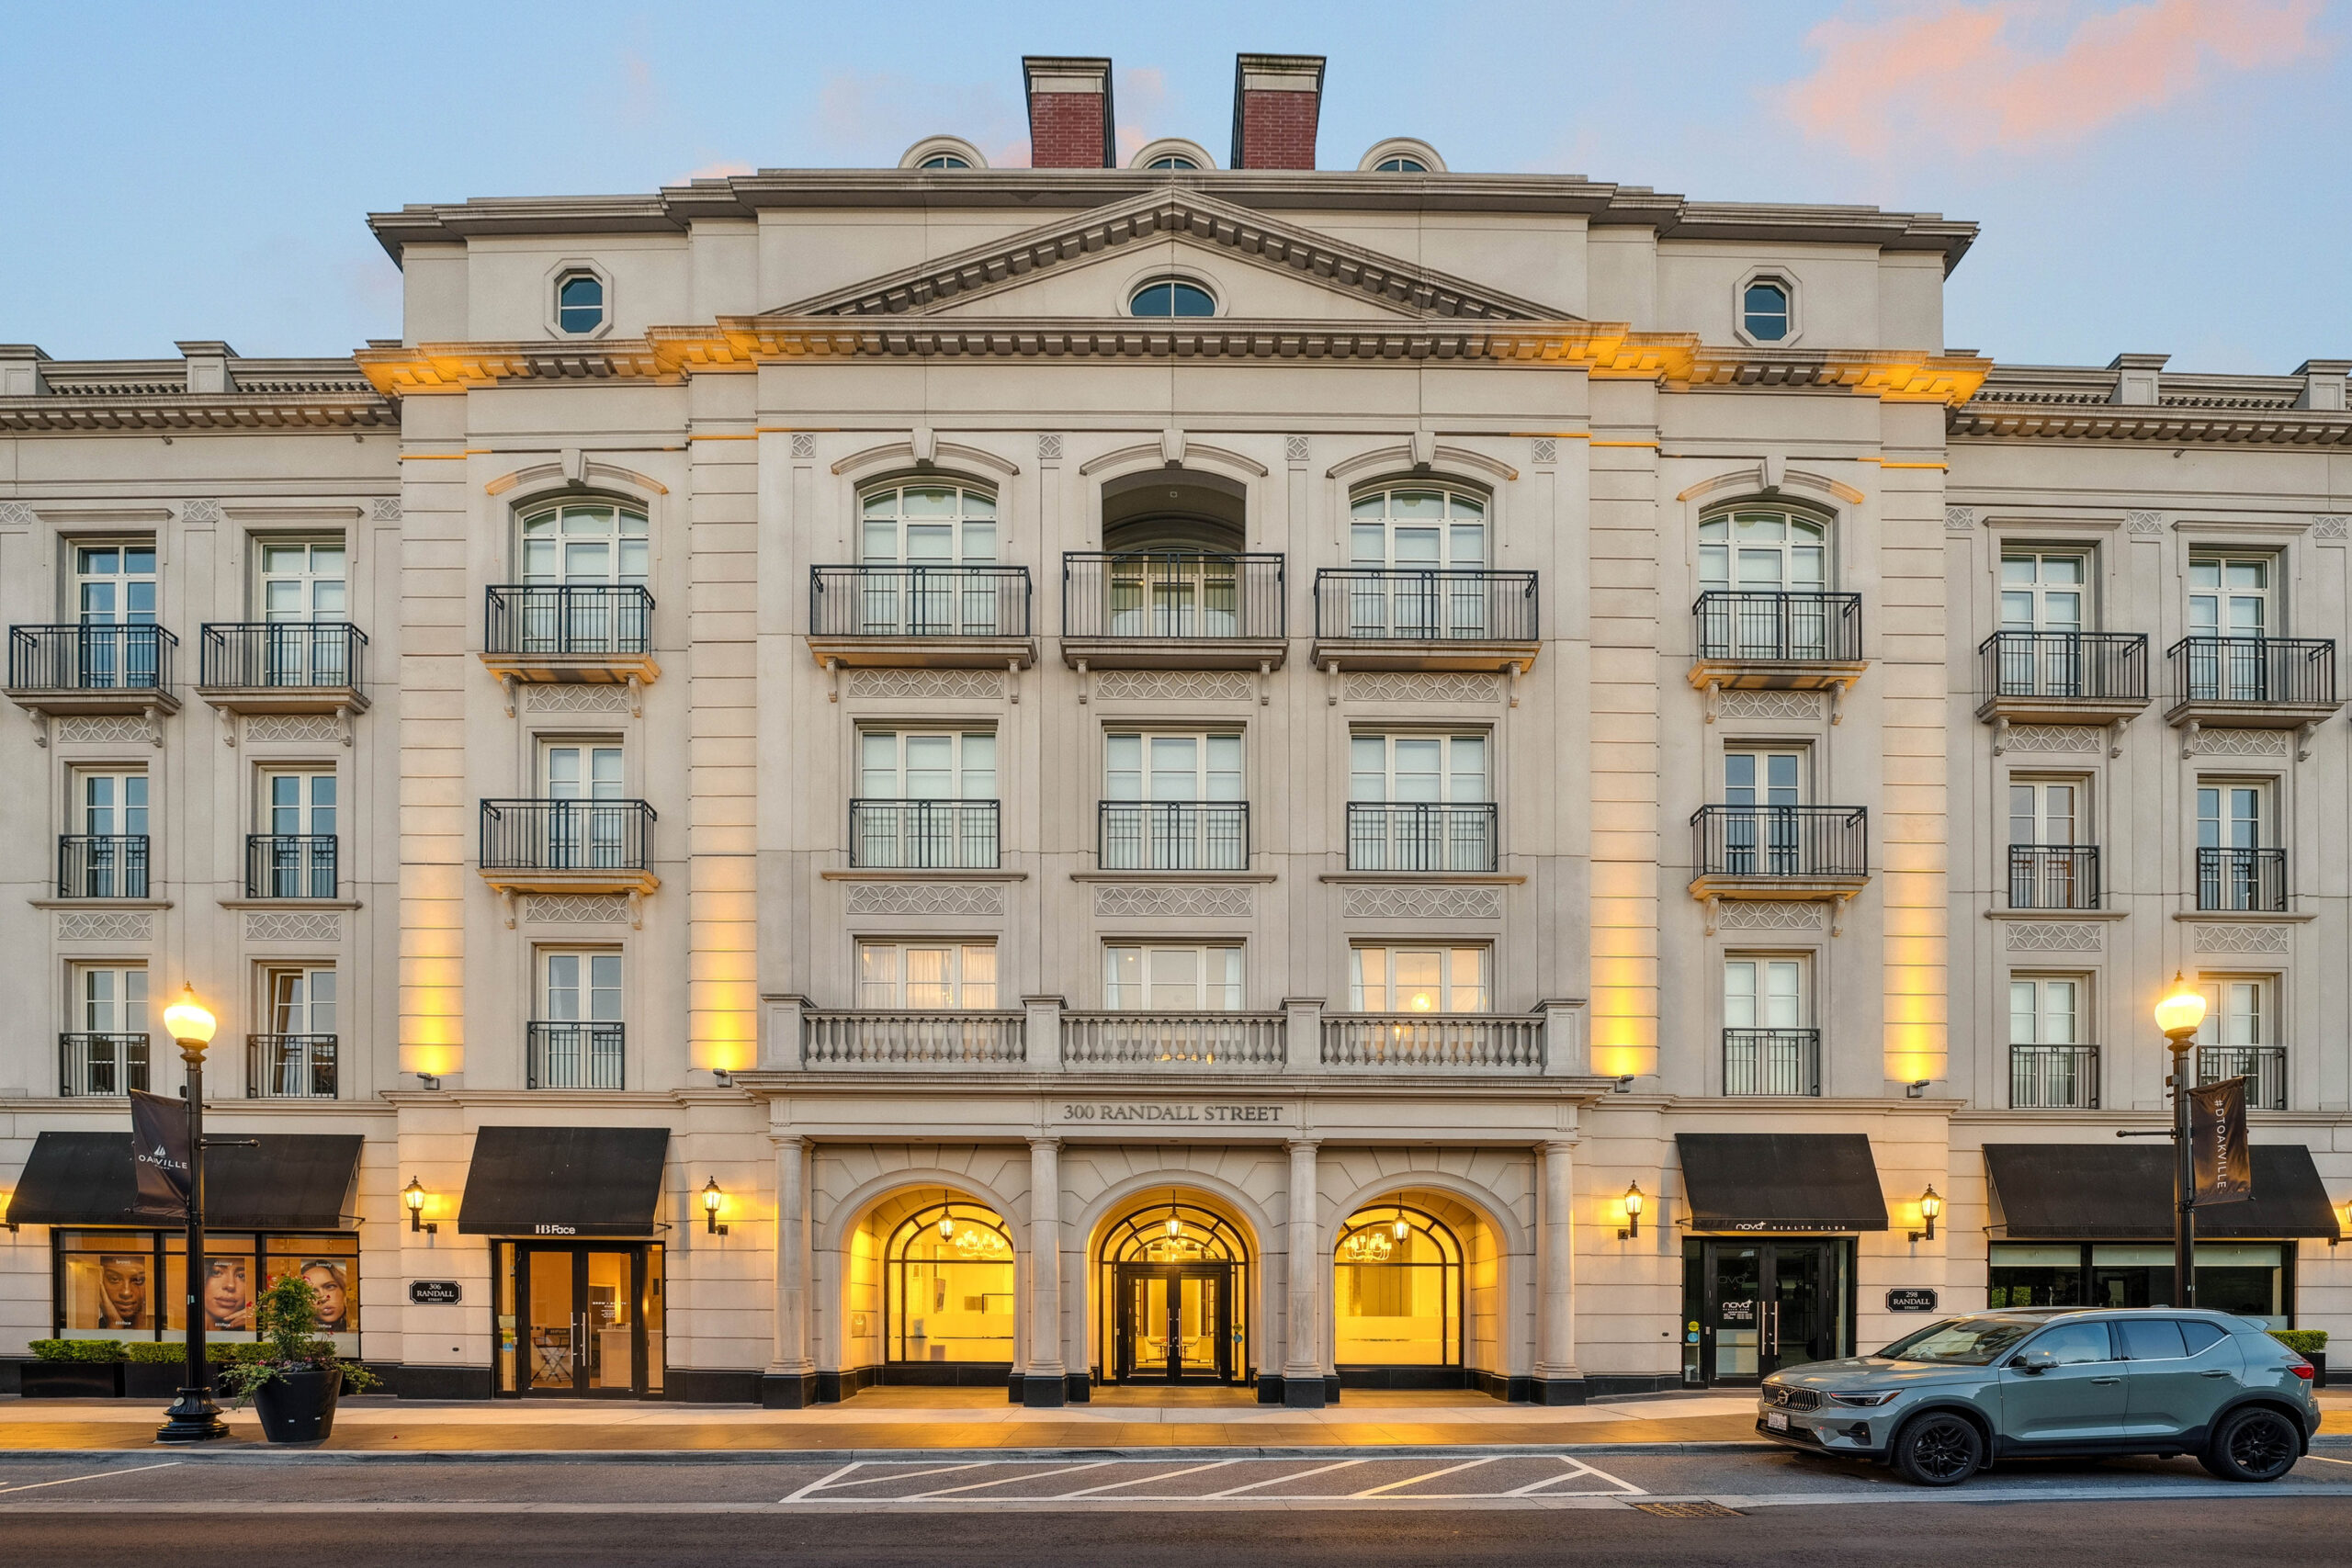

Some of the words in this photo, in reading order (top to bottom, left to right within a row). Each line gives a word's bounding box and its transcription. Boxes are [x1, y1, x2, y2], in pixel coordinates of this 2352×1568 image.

[1063, 1104, 1095, 1120] 300
[1100, 1105, 1199, 1121] RANDALL
[1204, 1105, 1283, 1122] STREET
[2214, 1099, 2227, 1189] #DTOAKVILLE
